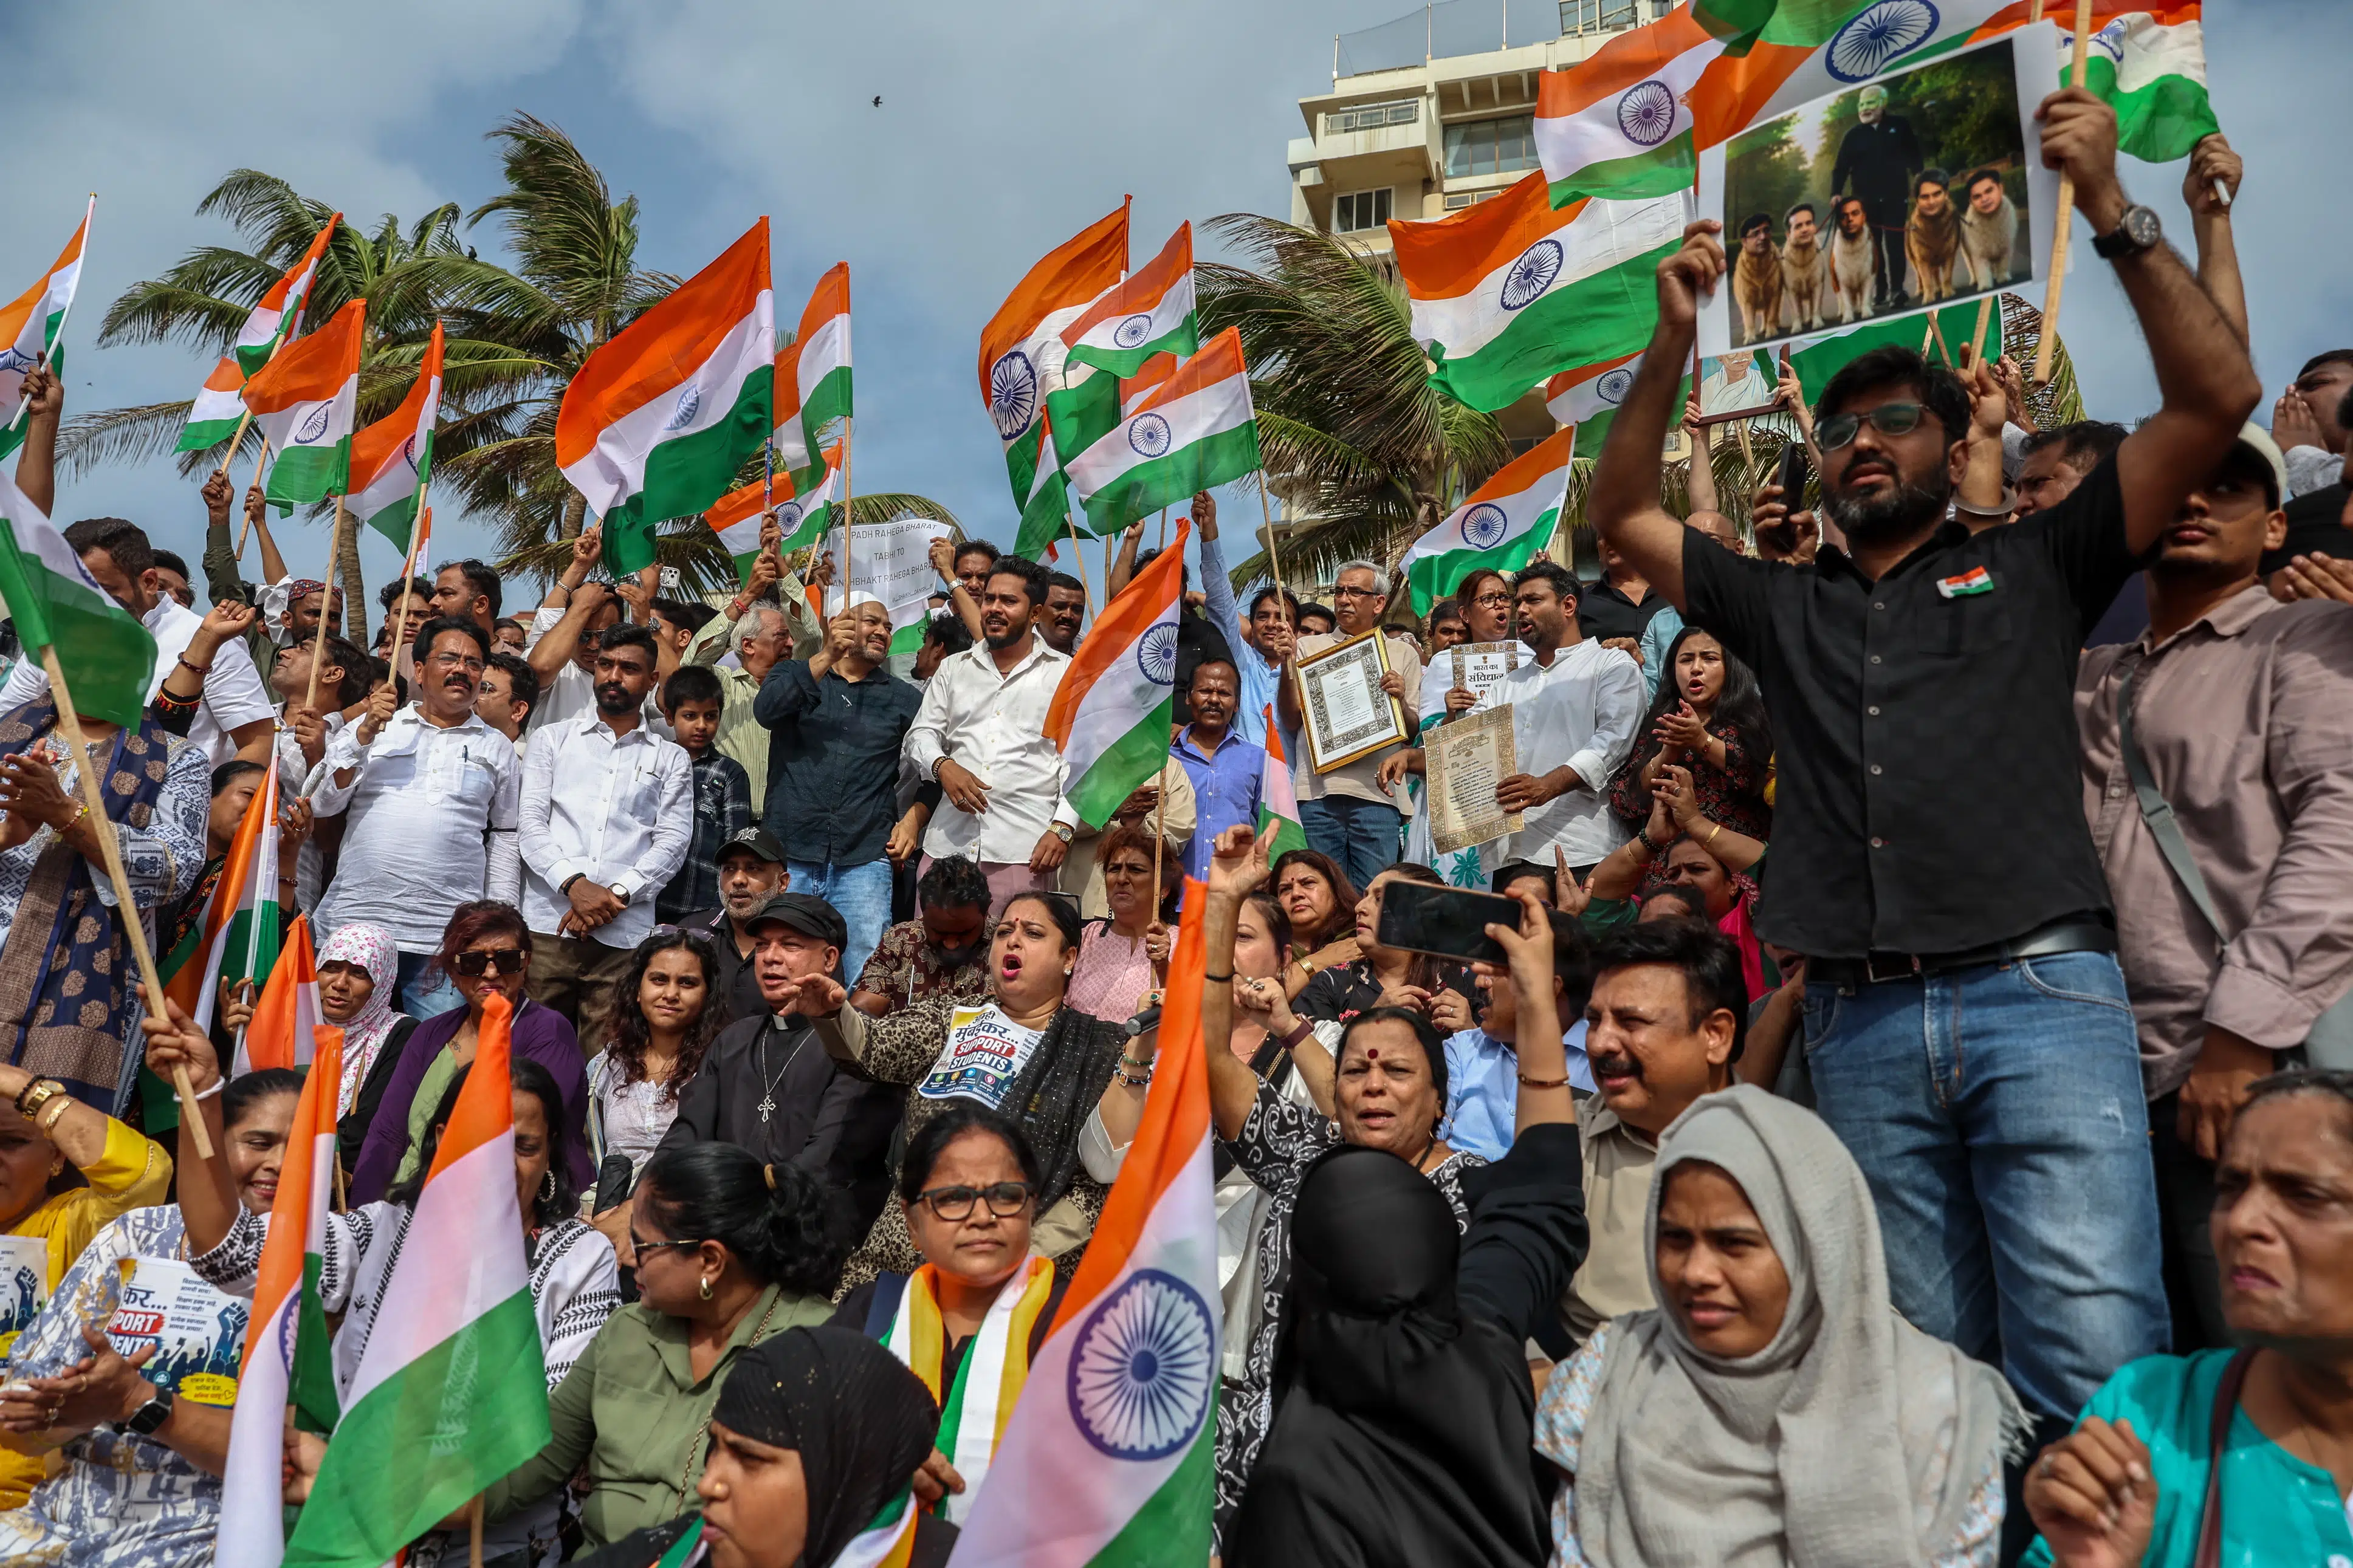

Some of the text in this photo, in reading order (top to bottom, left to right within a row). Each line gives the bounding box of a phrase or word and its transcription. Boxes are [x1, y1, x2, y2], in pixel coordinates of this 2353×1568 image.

[840, 523, 938, 540] APADH RAHEGA BHARAT
[874, 547, 904, 561] TABHI TO
[833, 561, 933, 587] ANHBHAKT RAHEGA BHARA
[1468, 672, 1504, 682] संविधान
[972, 1010, 996, 1024] आम्ही
[957, 1037, 1012, 1055] SUPPORT
[950, 1051, 1008, 1070] STUDENTS
[109, 1311, 158, 1332] PORT
